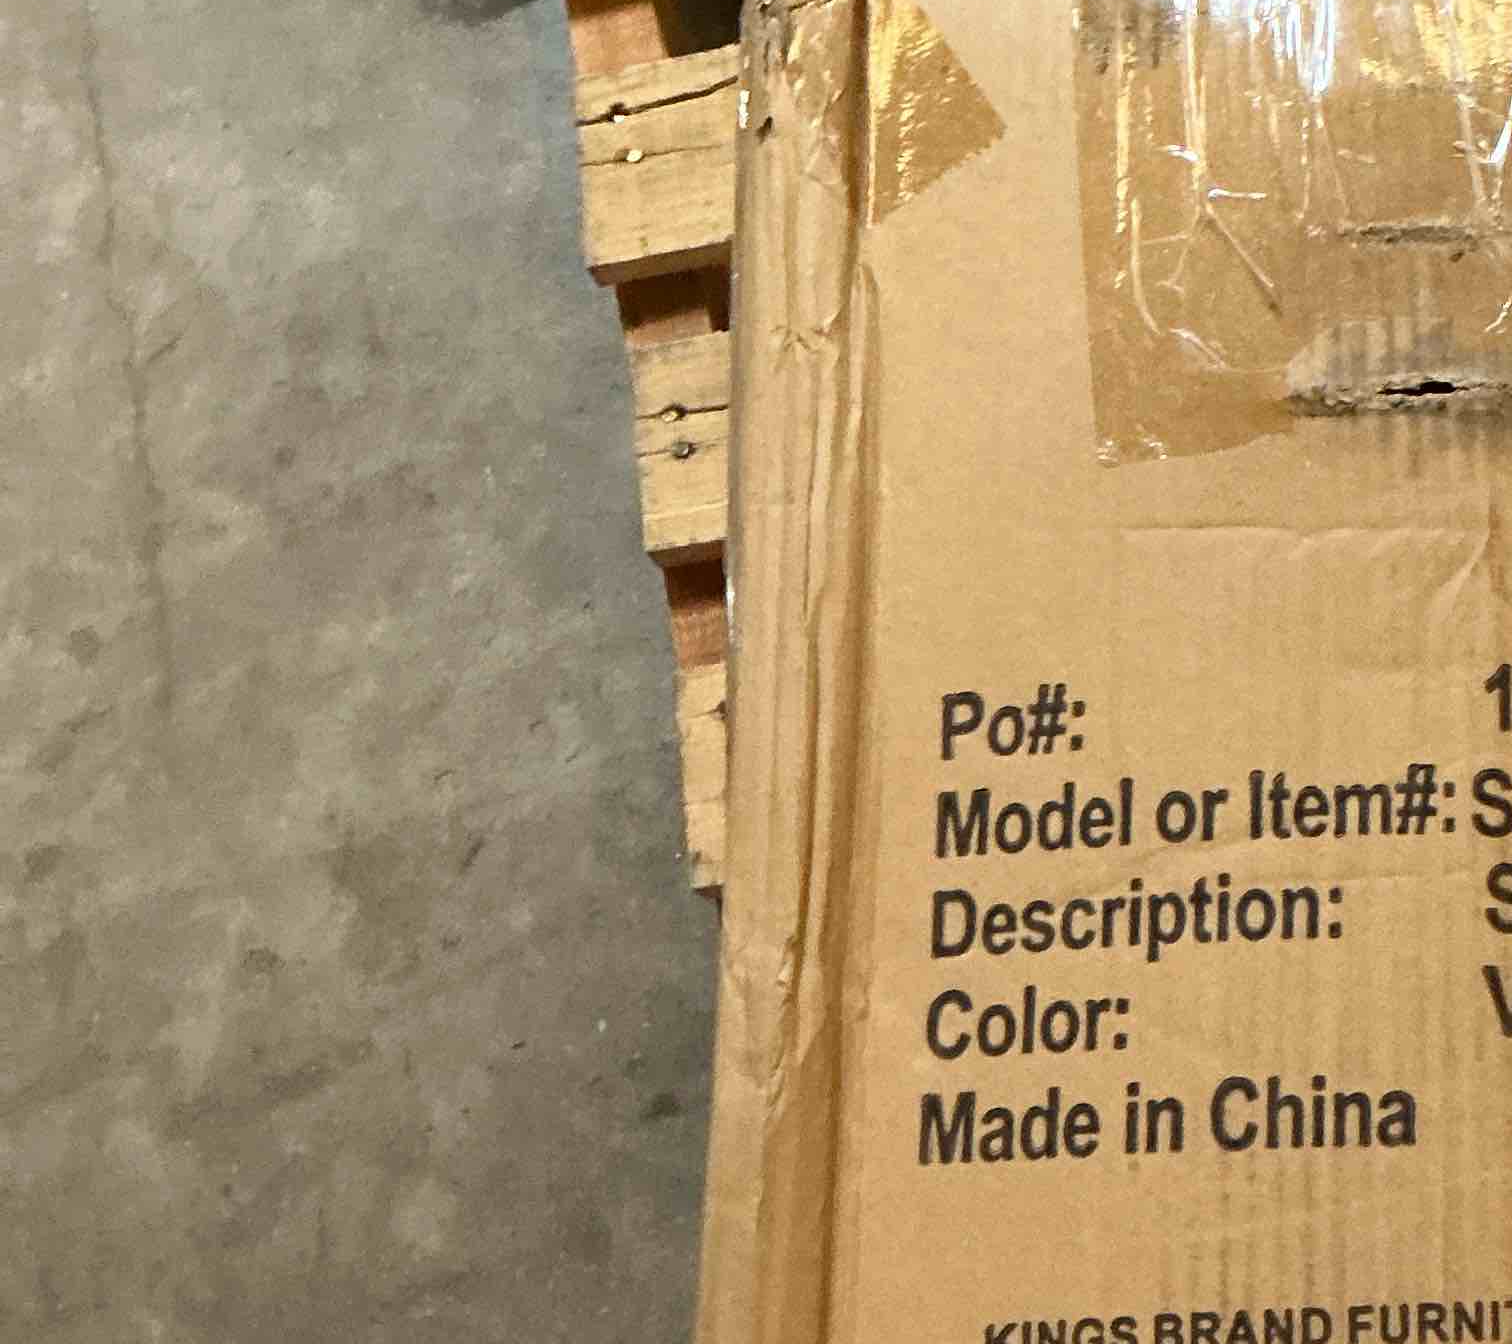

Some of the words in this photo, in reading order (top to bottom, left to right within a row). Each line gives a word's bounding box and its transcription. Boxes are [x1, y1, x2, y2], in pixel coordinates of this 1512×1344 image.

[940, 684, 1086, 761] Po#:
[934, 777, 1133, 859] Model
[1156, 789, 1229, 845] or
[1248, 764, 1457, 840] Item#:
[931, 872, 1345, 963] Description:
[925, 984, 1130, 1060] Color:
[918, 1086, 1101, 1166] Made
[1124, 1082, 1184, 1154] in
[1210, 1076, 1418, 1153] China
